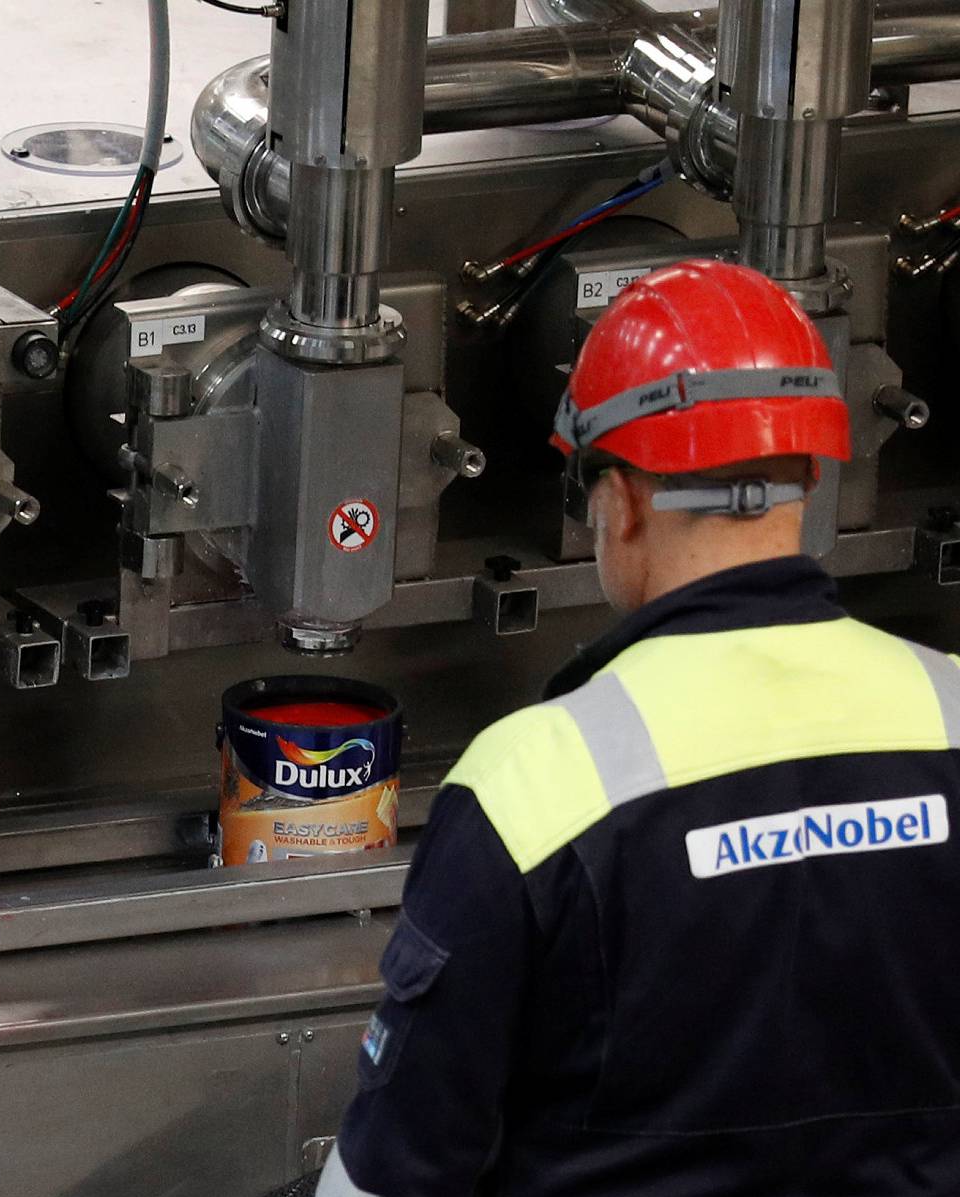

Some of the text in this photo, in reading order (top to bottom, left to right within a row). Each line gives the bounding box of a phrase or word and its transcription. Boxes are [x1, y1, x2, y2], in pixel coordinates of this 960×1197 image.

[583, 282, 603, 298] B2
[138, 331, 155, 347] B1
[780, 375, 818, 387] PELI
[638, 386, 671, 406] PELI
[275, 760, 363, 788] Dulux
[274, 836, 327, 846] WASHABLE
[337, 836, 367, 845] TOUGH
